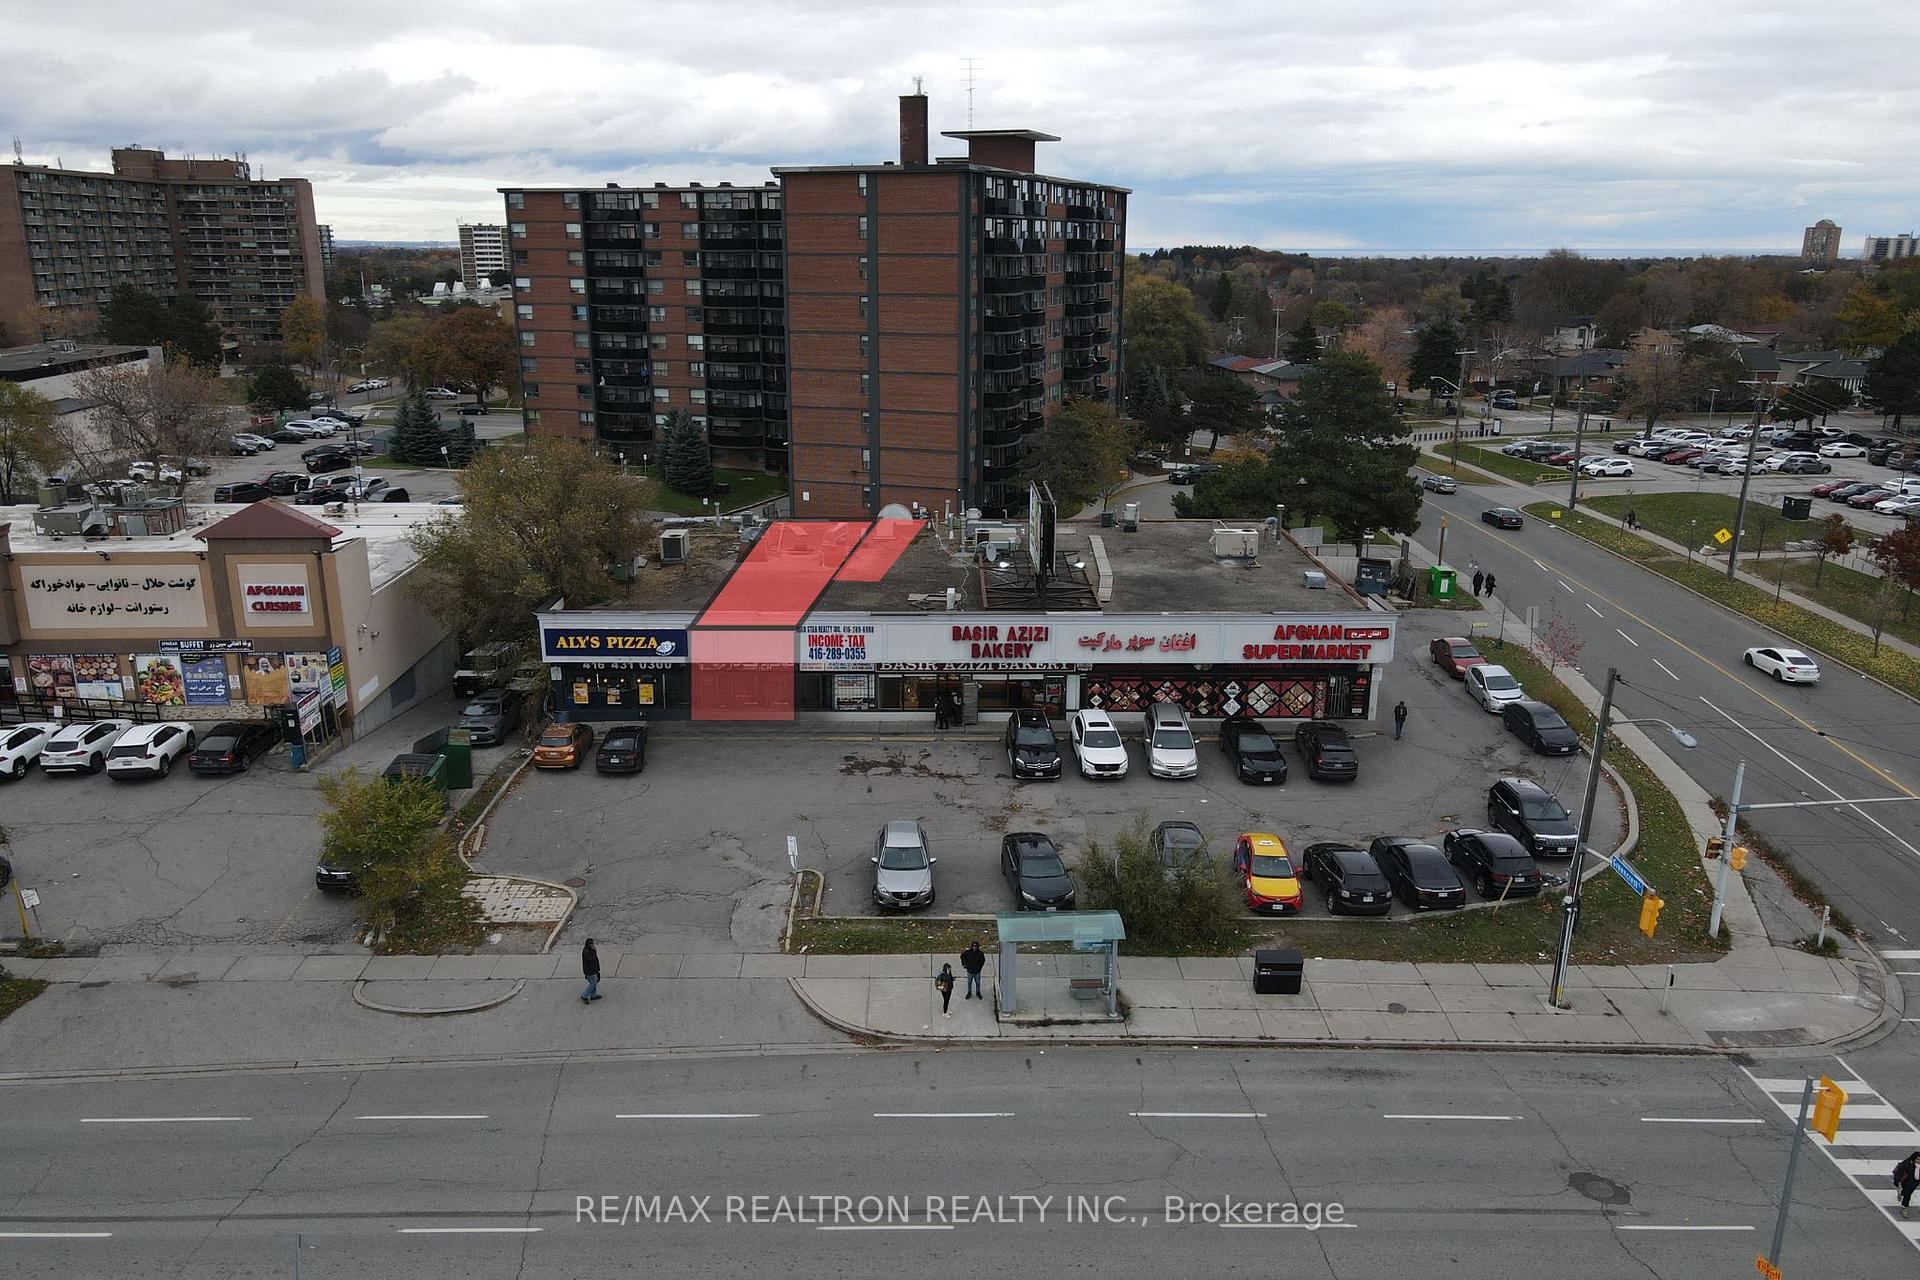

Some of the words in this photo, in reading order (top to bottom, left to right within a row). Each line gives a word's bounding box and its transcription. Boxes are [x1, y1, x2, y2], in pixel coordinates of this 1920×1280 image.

[142, 578, 165, 591] حلال
[66, 602, 87, 613] خانه
[251, 601, 302, 611] CUISINE
[952, 625, 998, 641] BASIR
[1007, 626, 1049, 641] AZIZI
[1274, 624, 1343, 640] AFGHAN
[556, 635, 600, 649] ALY'S
[606, 636, 659, 649] PIZZA
[1159, 632, 1196, 652] افغان
[809, 647, 866, 660] 416-289-0355
[971, 643, 1033, 658] BAKERY
[1243, 644, 1372, 660] SUPERMARKET
[582, 662, 605, 670] 416
[879, 663, 938, 671] BASIR
[943, 663, 994, 671] AZIZI
[998, 663, 1069, 671] BAKERY
